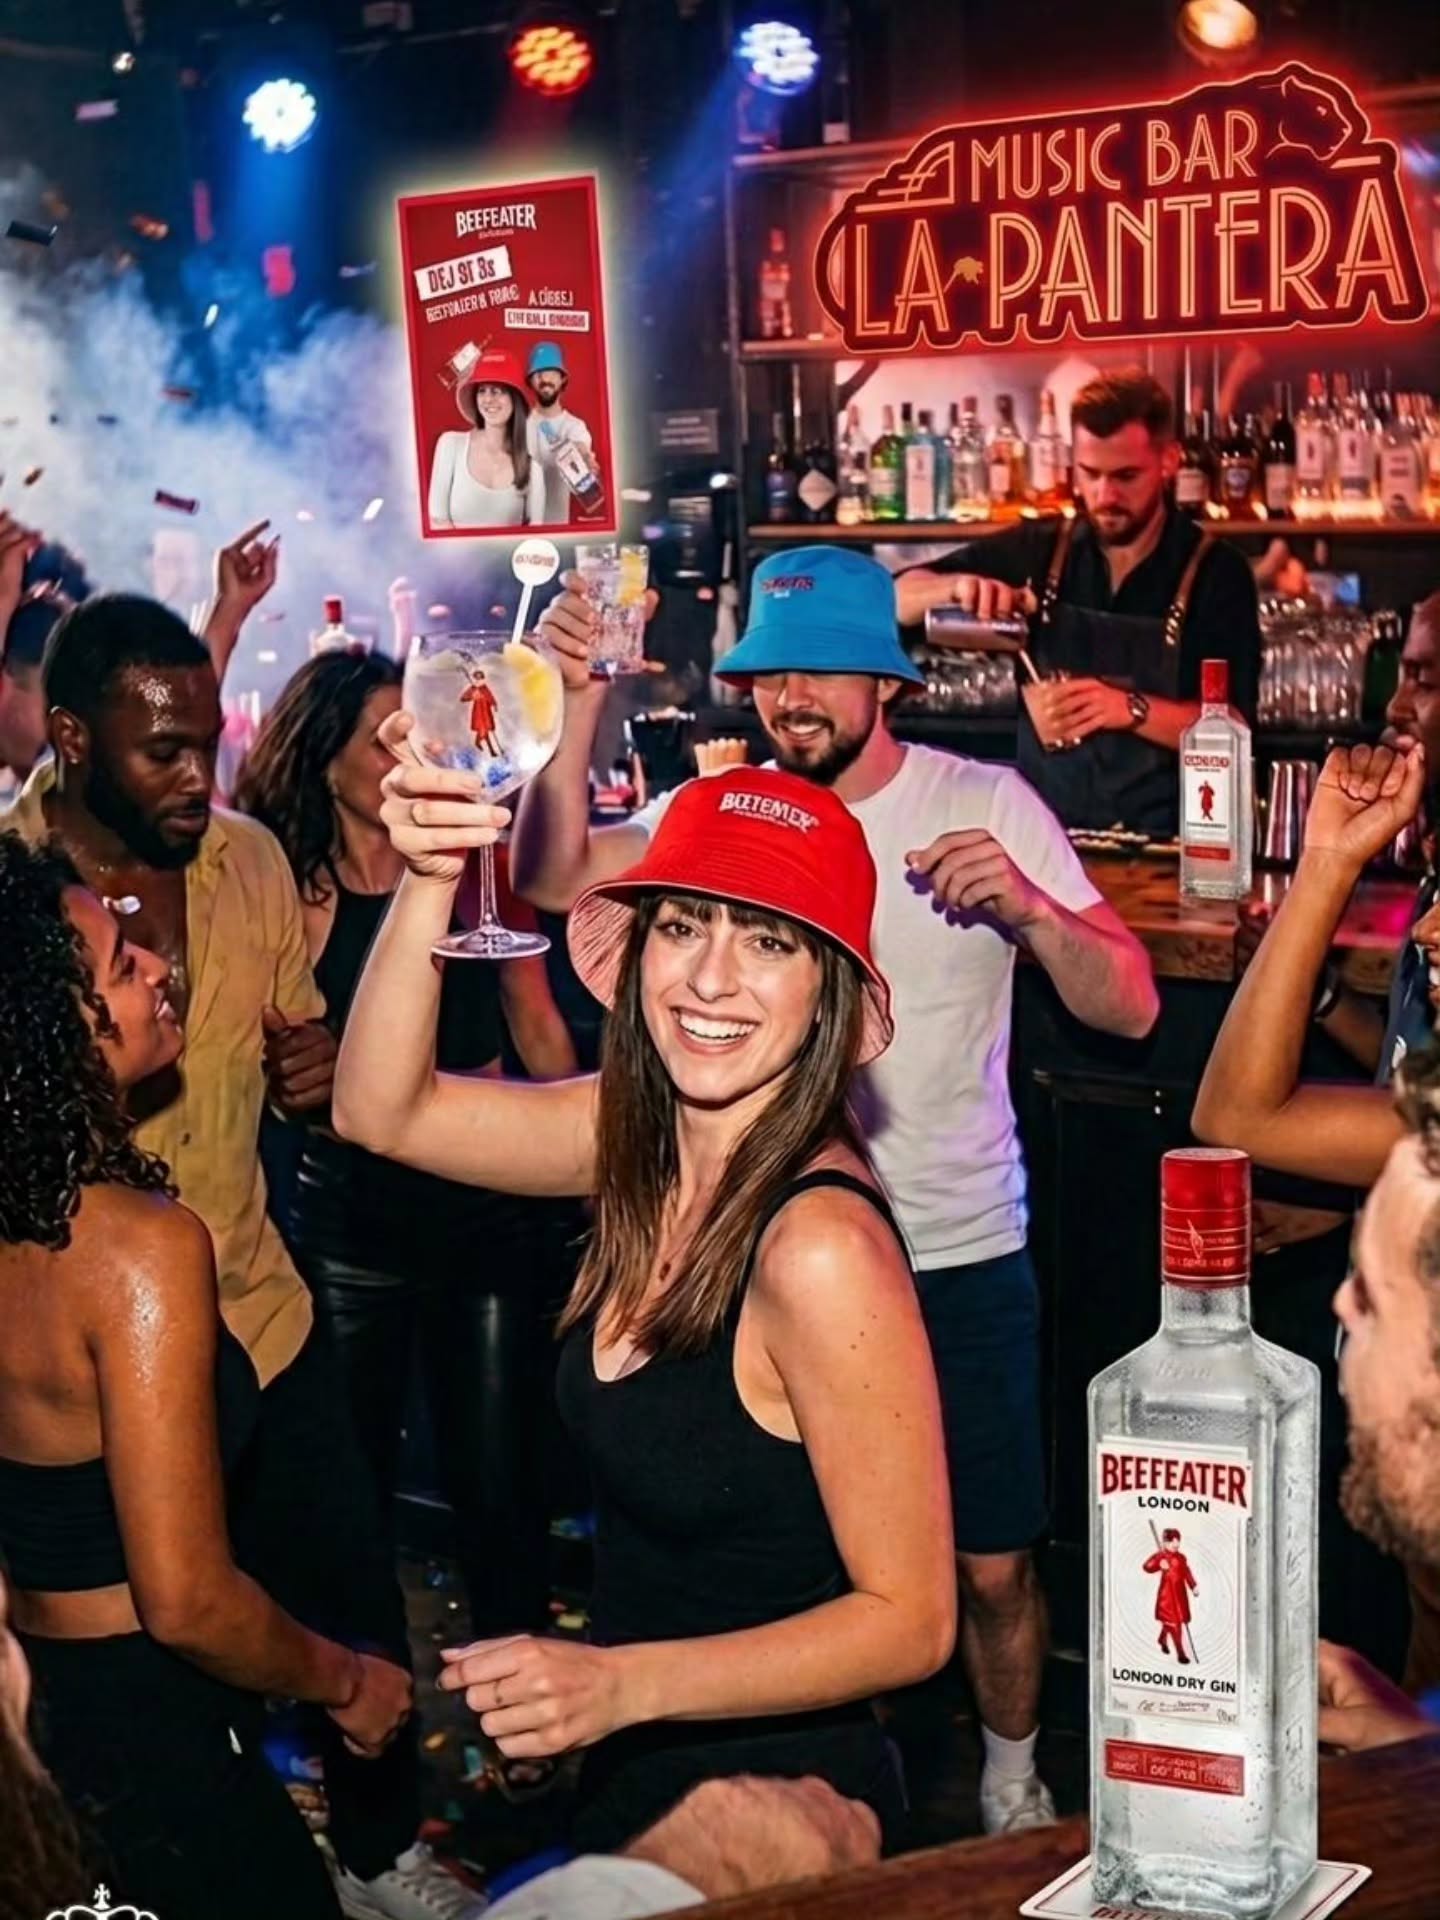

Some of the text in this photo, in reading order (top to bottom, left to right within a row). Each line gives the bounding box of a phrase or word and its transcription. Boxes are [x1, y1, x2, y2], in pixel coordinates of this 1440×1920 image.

[971, 111, 1258, 203] MUSIC BAR
[456, 204, 537, 237] BEEFEATER
[855, 178, 1410, 337] LA PANTERA
[428, 264, 455, 293] DEJ
[1101, 1453, 1247, 1509] BEEFEATER
[1138, 1496, 1210, 1513] LONDON
[1177, 1676, 1206, 1690] DRY
[1210, 1680, 1236, 1693] GIN
